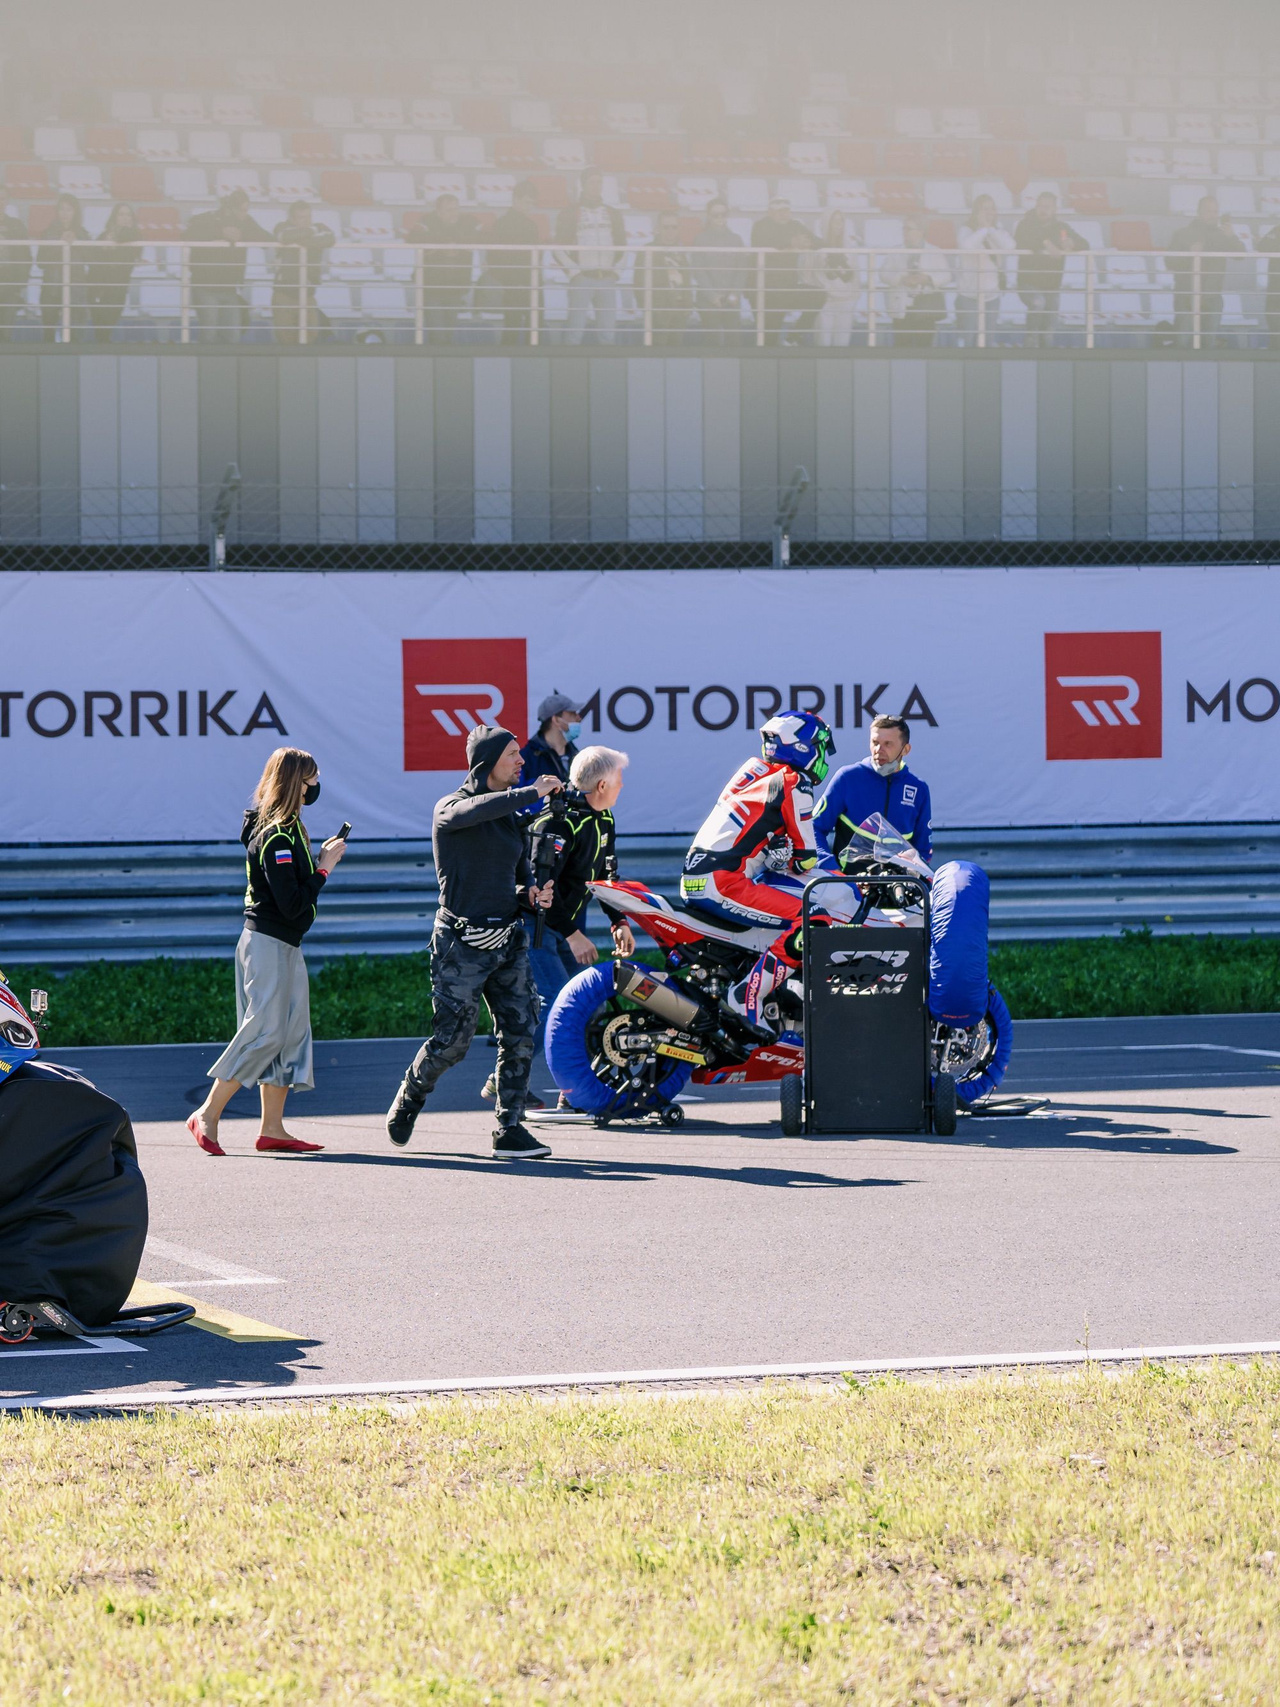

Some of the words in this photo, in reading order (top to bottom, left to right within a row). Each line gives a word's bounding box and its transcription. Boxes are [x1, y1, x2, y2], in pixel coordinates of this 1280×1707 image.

[721, 899, 783, 926] VIRCOS
[825, 950, 910, 968] SPB
[826, 973, 909, 984] RACING
[748, 972, 760, 1010] daytona
[830, 983, 904, 996] TEAM
[755, 1052, 797, 1066] SPB
